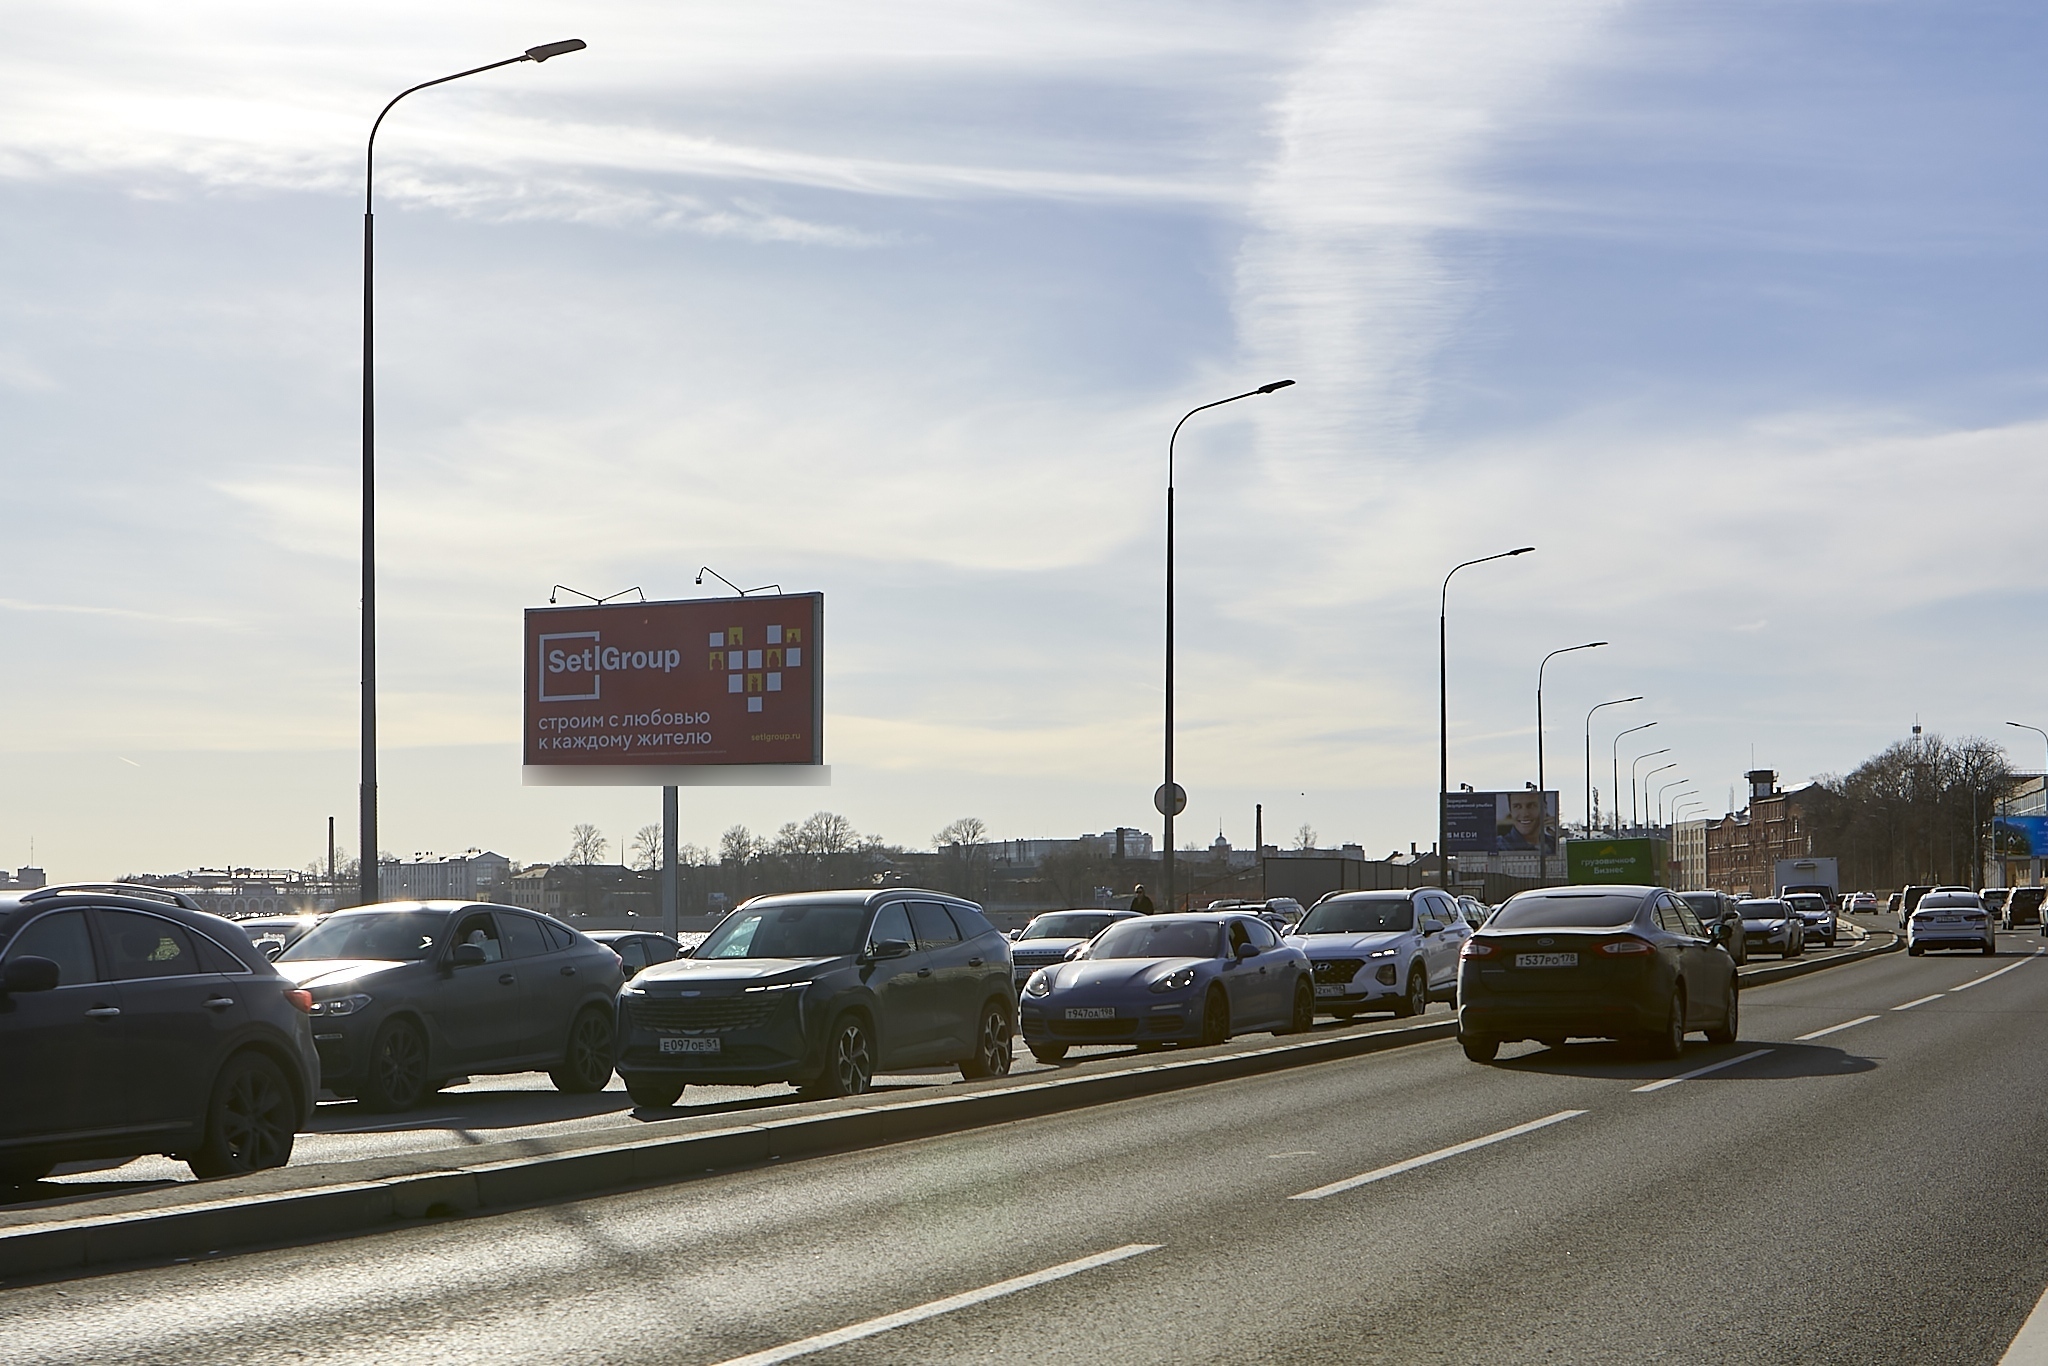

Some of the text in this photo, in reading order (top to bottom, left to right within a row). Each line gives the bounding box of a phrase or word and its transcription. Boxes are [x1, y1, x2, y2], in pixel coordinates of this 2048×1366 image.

[538, 709, 710, 734] строим с любовью
[538, 730, 712, 751] к каждому жителю
[751, 732, 801, 744] setlgroup.ru
[1593, 866, 1624, 875] Бизнес
